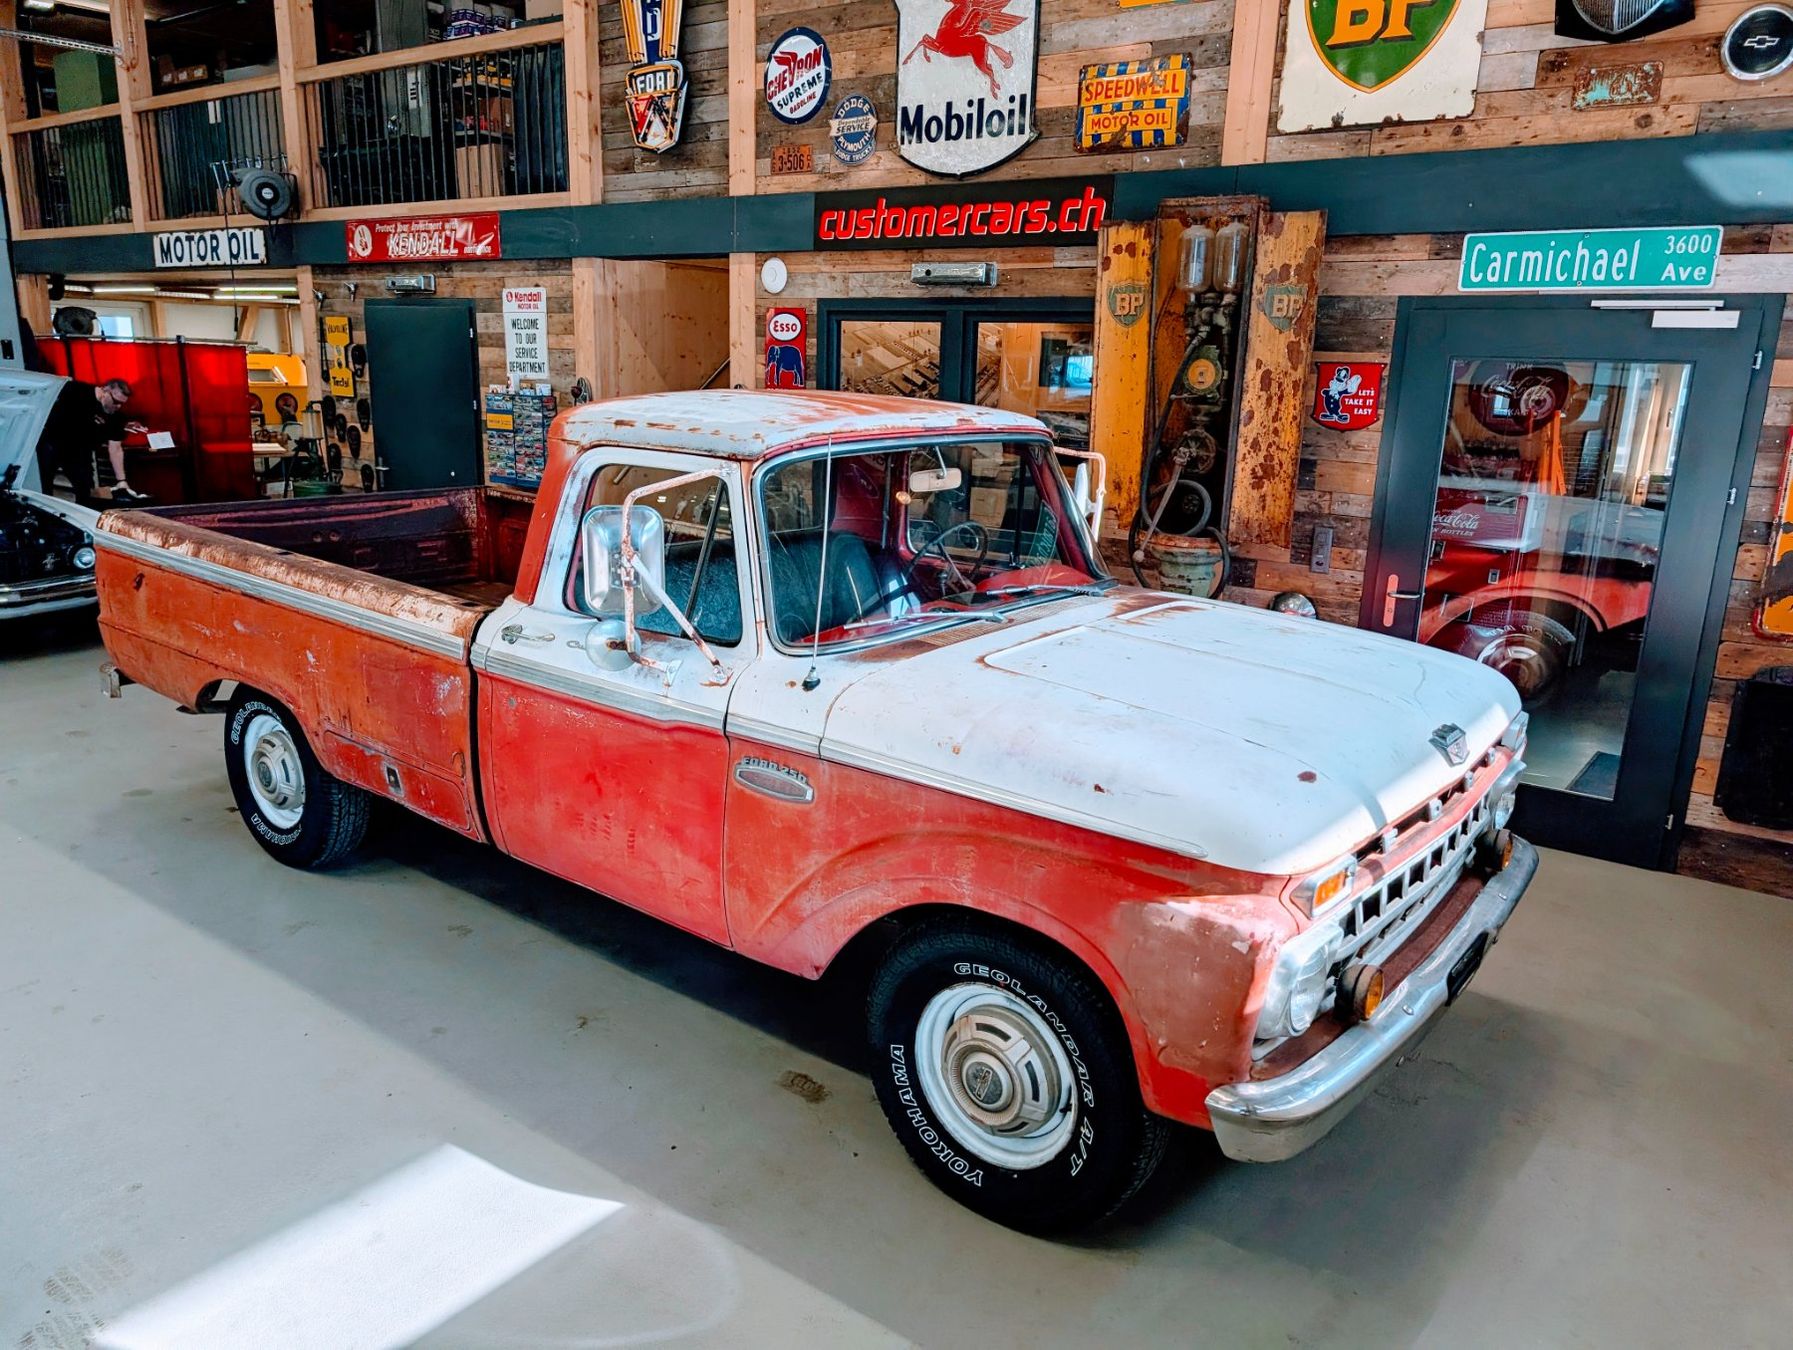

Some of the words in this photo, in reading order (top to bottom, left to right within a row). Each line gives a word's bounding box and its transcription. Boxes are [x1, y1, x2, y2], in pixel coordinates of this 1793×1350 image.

[767, 45, 823, 101] CHEVRON
[777, 72, 823, 109] SUPREME
[789, 91, 817, 114] GASOLINE
[838, 98, 870, 117] DODGE
[836, 122, 870, 133] SERVICE
[900, 93, 1027, 145] Mobiloil
[1091, 113, 1139, 130] MOTOR
[1144, 112, 1168, 126] OIL
[837, 132, 871, 152] PLYMOUTH
[819, 186, 1106, 239] customercars.ch
[159, 232, 221, 264] MOTOR
[228, 230, 260, 262] OIL
[388, 231, 459, 257] KENDALL
[1664, 234, 1713, 255] 3600
[1470, 239, 1641, 283] Carmichael
[1660, 262, 1708, 281] Ave
[515, 292, 542, 302] Kendall
[1114, 293, 1146, 317] BP
[511, 318, 539, 330] WELCOME
[773, 320, 798, 333] Esso
[515, 333, 523, 345] TO
[525, 333, 537, 345] OUR
[515, 347, 538, 359] SERVICE
[509, 361, 546, 373] DEPARTMENT
[1344, 398, 1363, 406] TAKE
[1366, 398, 1374, 406] IT
[953, 962, 1095, 1108] GEOLANDAR
[1069, 1116, 1095, 1177] A/T
[890, 1044, 984, 1187] YOKOHAMA
